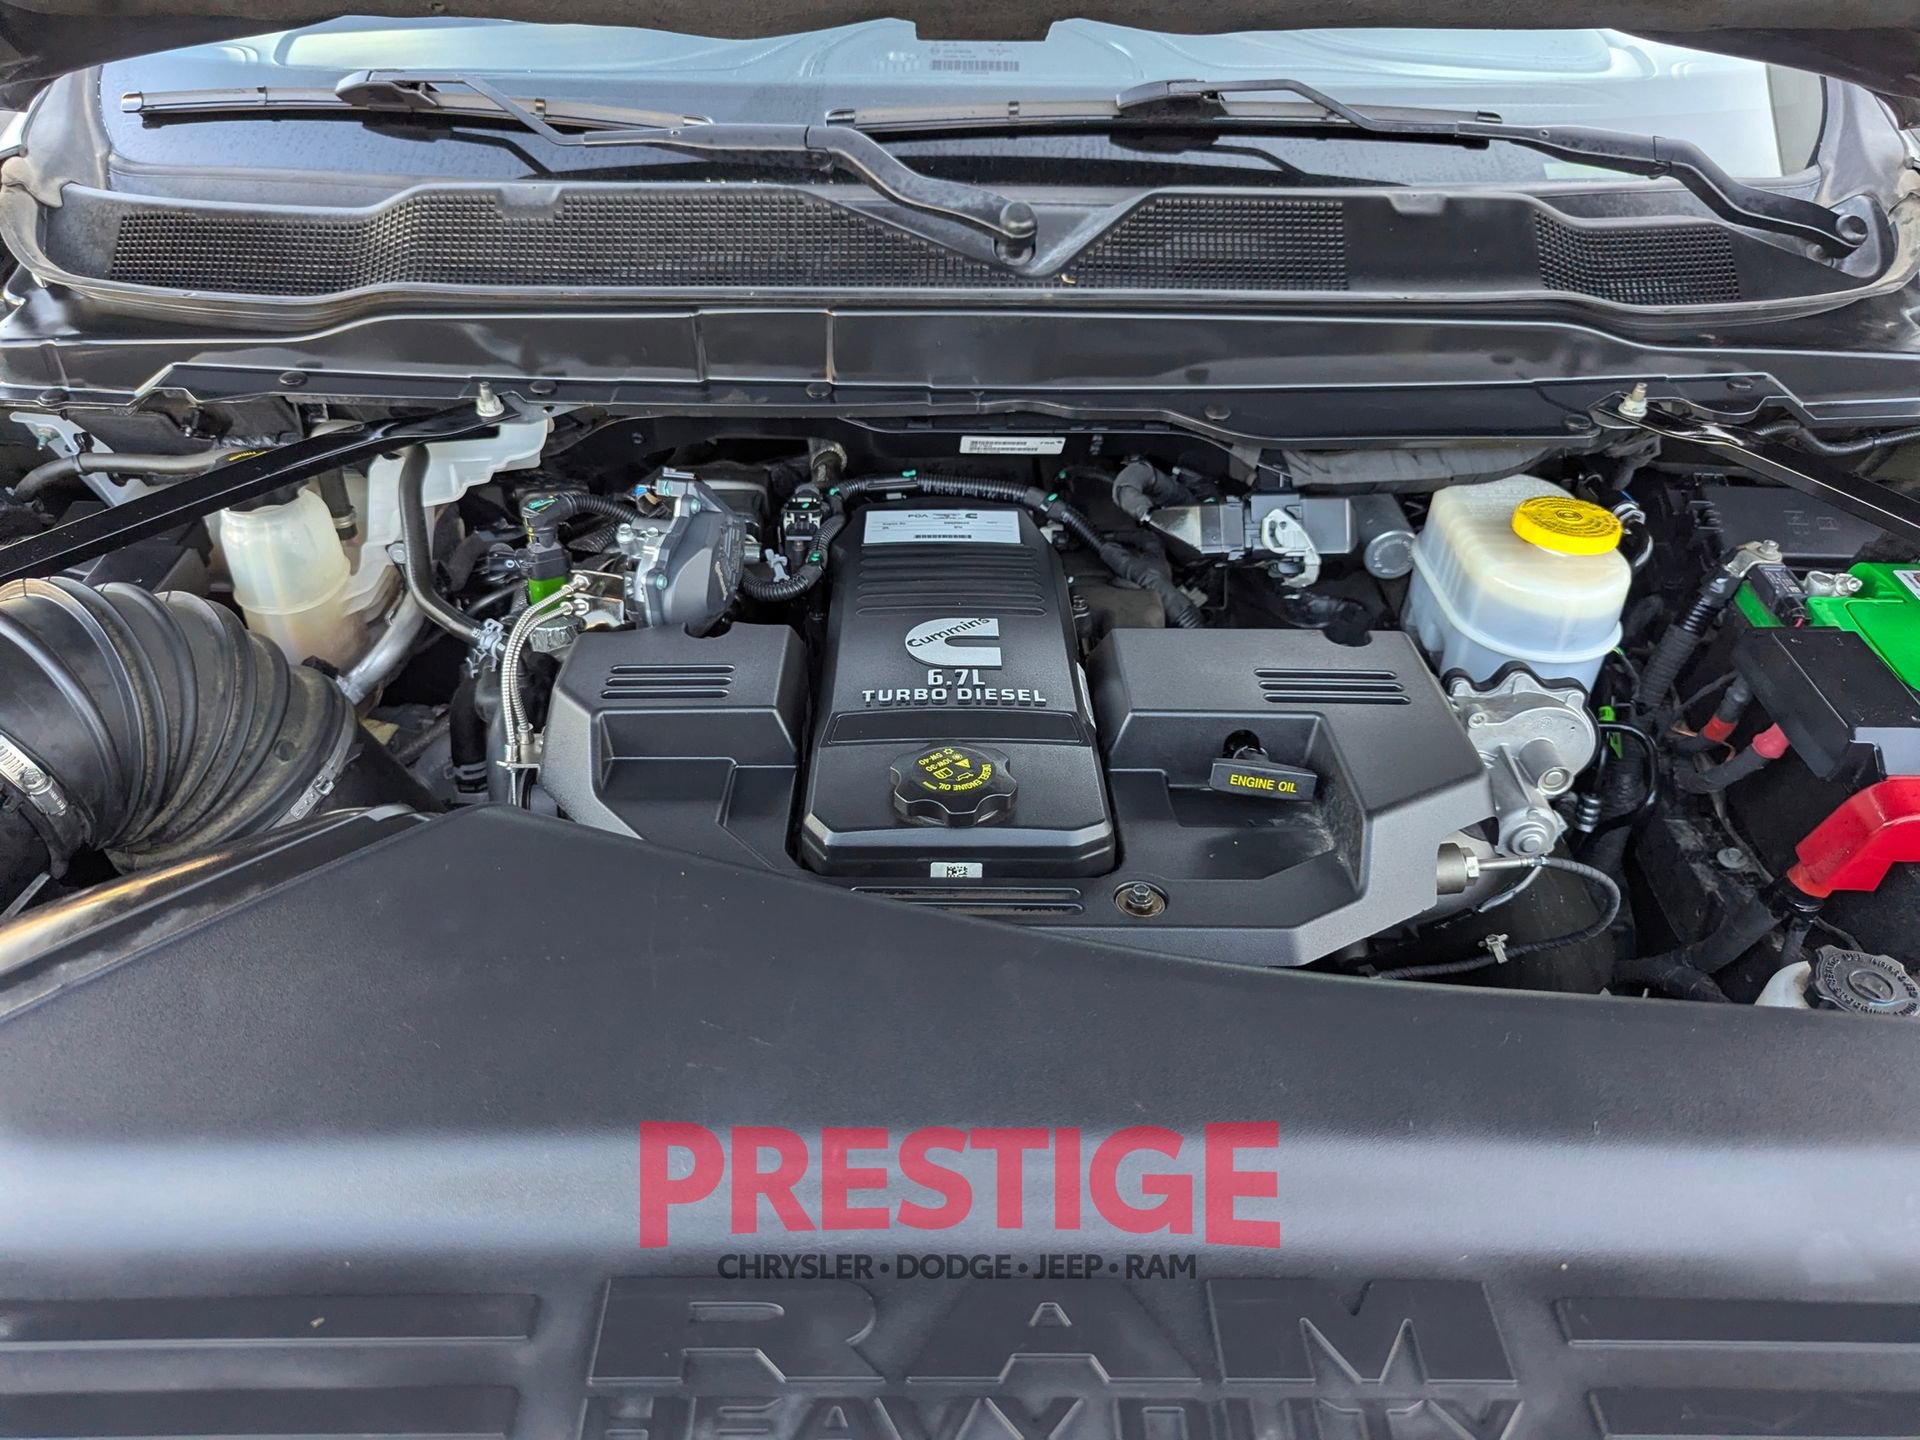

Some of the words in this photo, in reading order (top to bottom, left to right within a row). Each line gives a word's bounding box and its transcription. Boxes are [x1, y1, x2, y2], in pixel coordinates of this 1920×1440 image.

[907, 617, 990, 648] Cummins
[927, 668, 986, 686] 6.7L
[862, 688, 948, 704] TURBO
[957, 687, 1047, 704] DIESEL
[938, 782, 951, 791] OIL
[1229, 773, 1276, 791] ENGINE
[1278, 781, 1297, 793] OIL
[587, 1276, 1517, 1385] RAM
[574, 1396, 1084, 1440] HEAVY
